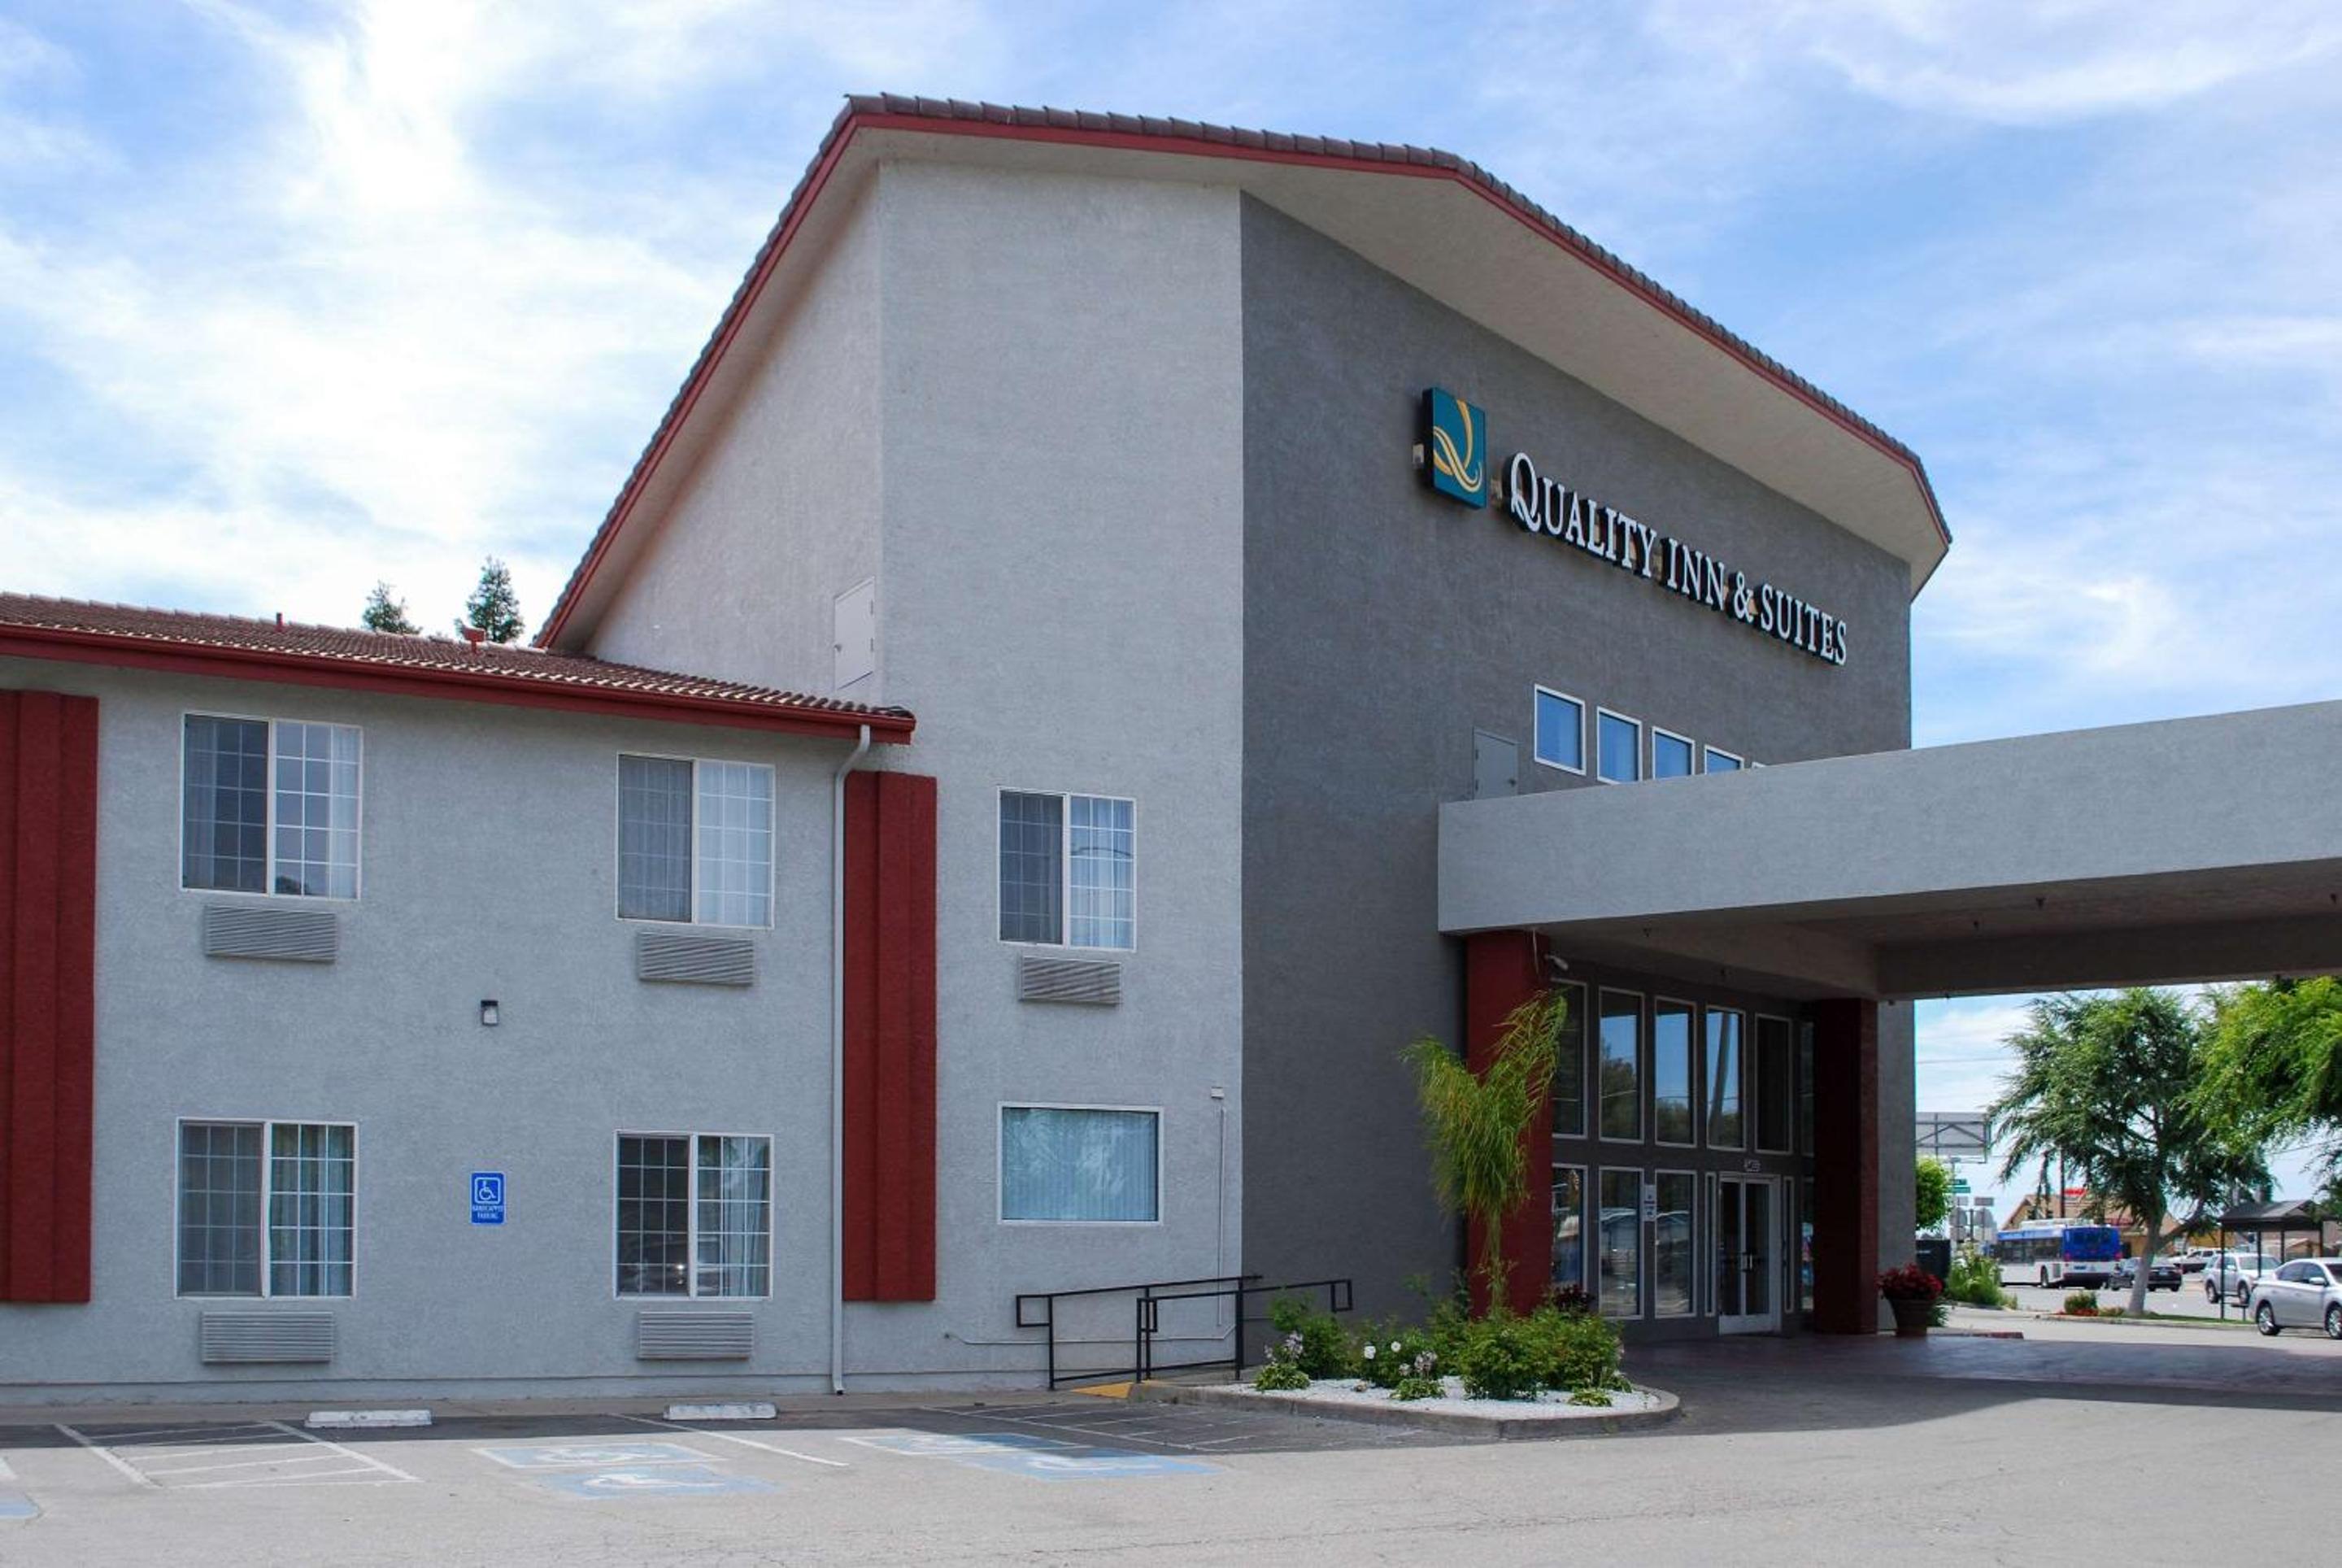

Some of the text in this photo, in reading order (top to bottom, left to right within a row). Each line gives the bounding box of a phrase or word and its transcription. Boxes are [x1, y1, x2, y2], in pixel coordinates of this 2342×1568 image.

[1509, 451, 1847, 666] QUALITY INN & SUITES
